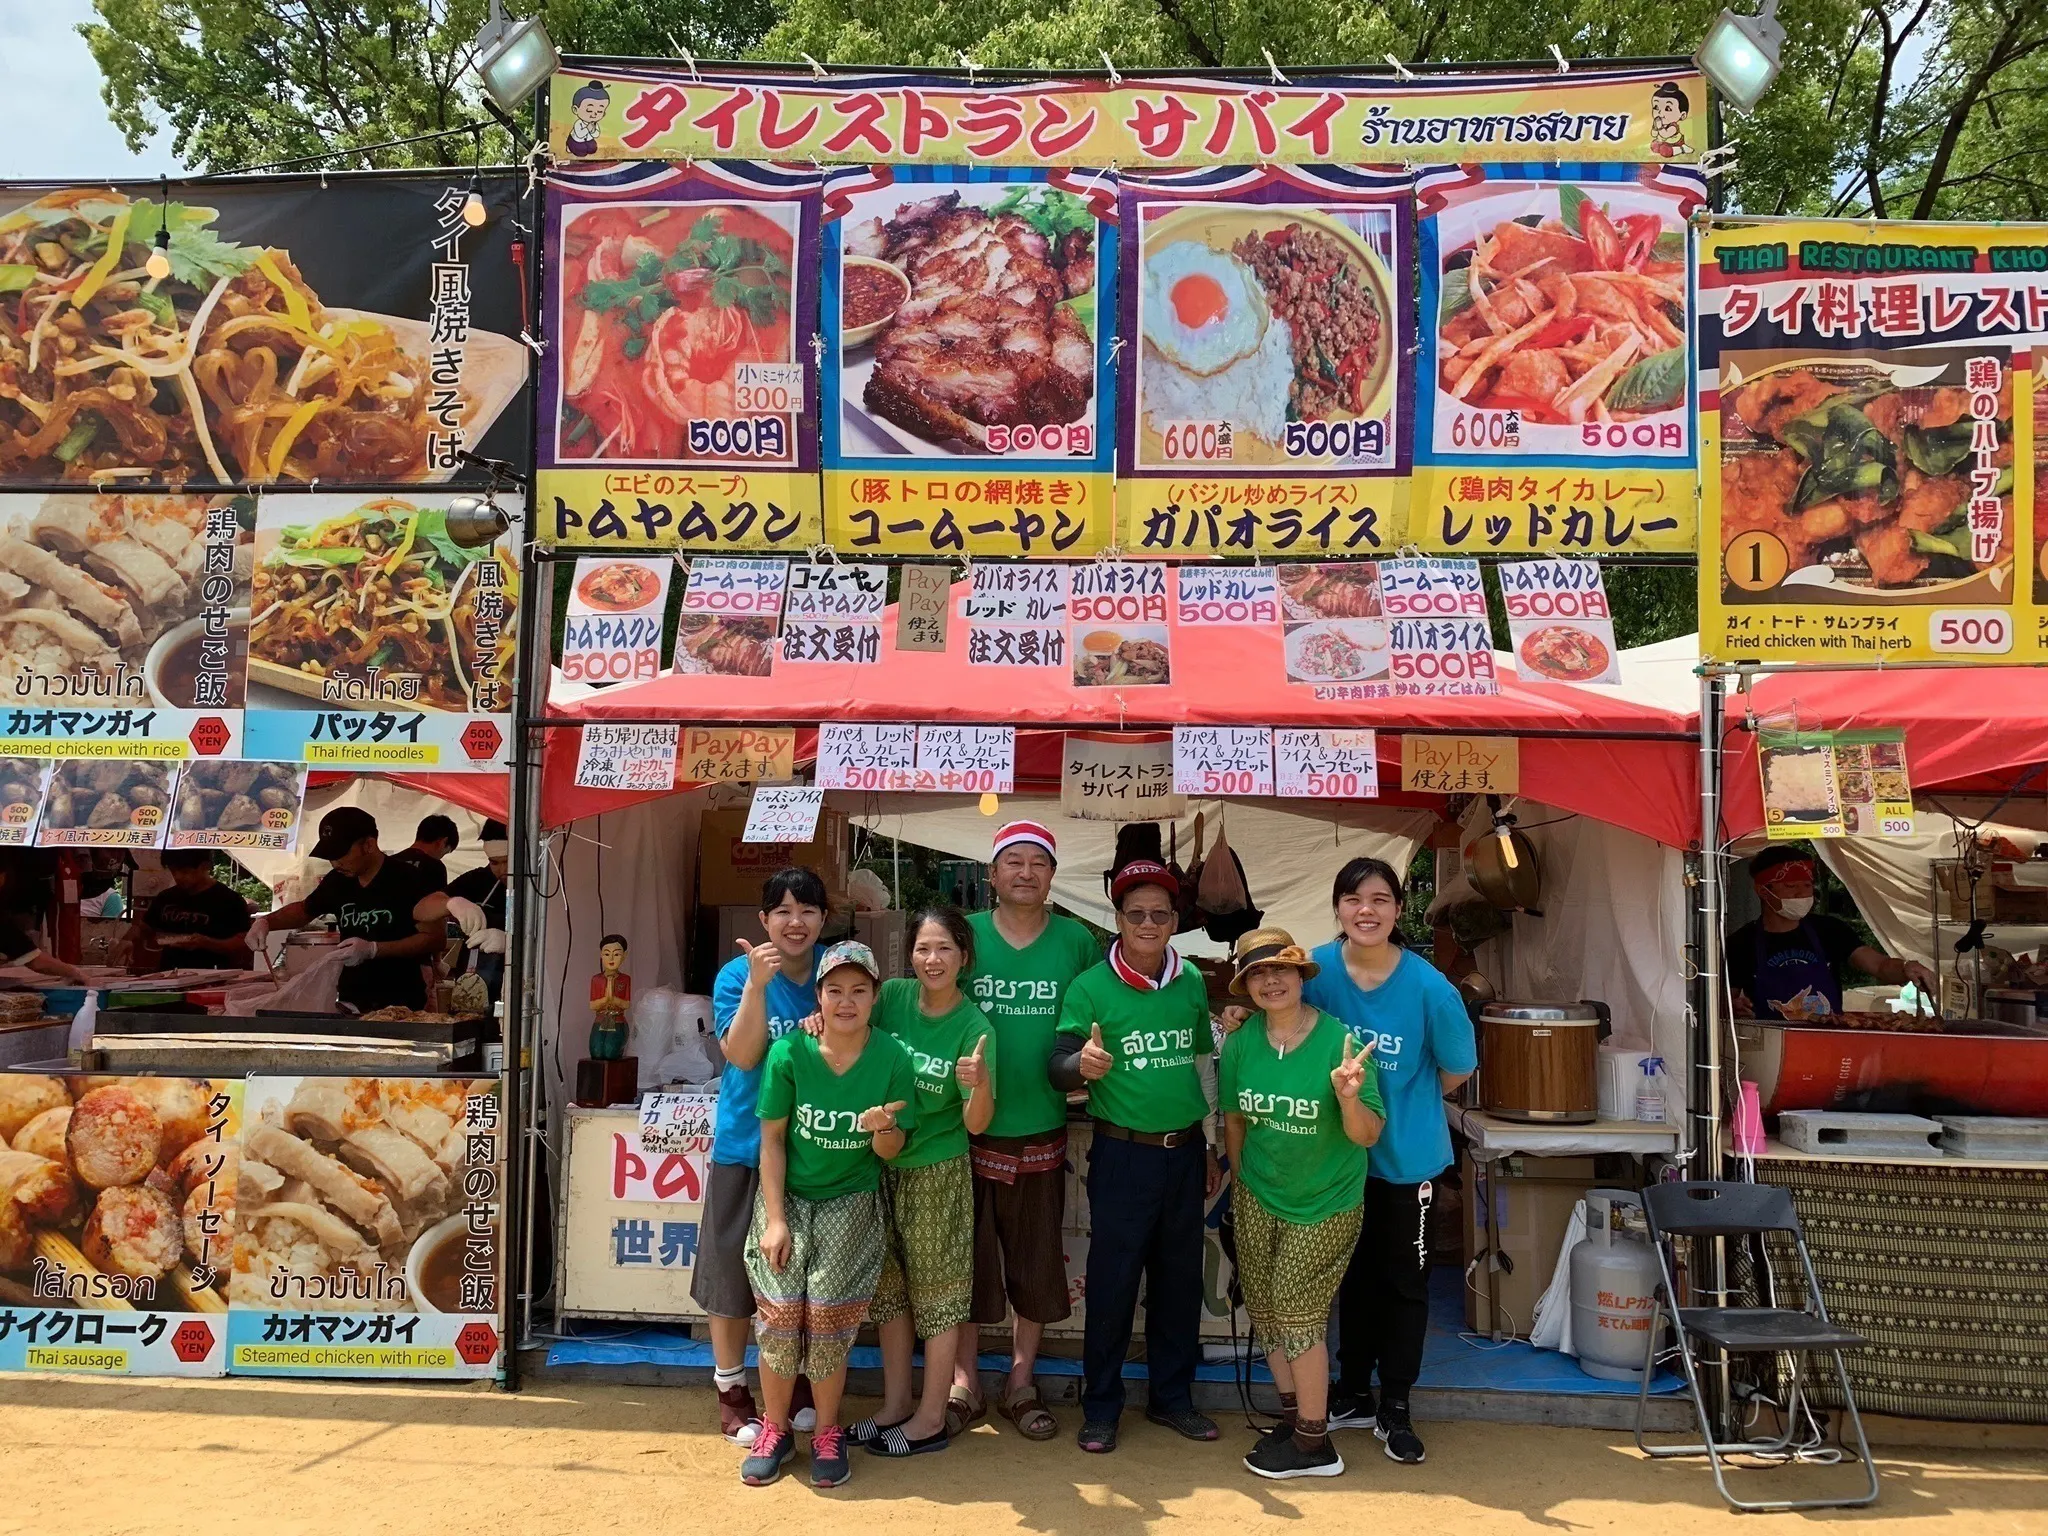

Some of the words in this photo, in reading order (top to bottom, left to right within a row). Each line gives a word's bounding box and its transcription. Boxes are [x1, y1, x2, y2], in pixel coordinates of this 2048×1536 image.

[621, 83, 1098, 159] タイレストラン
[1127, 90, 1346, 159] サバイ
[1361, 105, 1629, 147] ร้านอาหารสบาย
[1716, 244, 1787, 272] THAI
[1801, 243, 1976, 271] RESTAURANT
[1722, 282, 2048, 336] タイ料理レスト
[427, 186, 473, 472] タイ風焼きそば
[736, 387, 802, 411] 300円
[688, 418, 787, 455] 500円
[986, 424, 1093, 454] 500円
[1164, 422, 1219, 459] 600
[1284, 420, 1385, 457] 500円
[1450, 412, 1504, 448] 600
[1581, 423, 1682, 450] 500円
[1968, 359, 2003, 562] 鶏のハーブ揚げ
[604, 474, 750, 498] (エビのスープ)
[849, 478, 1088, 507] (豚トロの網焼き)
[1165, 481, 1359, 507] (バジル炒めライス)
[1446, 476, 1666, 504] (鶏肉タイカレー)
[553, 495, 802, 543] トムヤムクン
[848, 507, 1088, 549] コームーヤン
[1143, 505, 1385, 549] ガパオライス
[1441, 506, 1678, 549] レッドカレー
[688, 571, 785, 591] コームーヤン
[907, 568, 945, 594] Pay
[971, 566, 1059, 593] ガパオライス
[1071, 565, 1165, 596] ガパオライス
[1382, 572, 1480, 592] コームーヤン
[1502, 564, 1600, 592] トムヤムクン
[683, 590, 781, 613] 500円
[788, 591, 883, 613] トムヤムクン
[1178, 579, 1276, 602] レッドカレー
[194, 507, 238, 706] 鶏肉のせご飯
[908, 591, 946, 617] Pay
[964, 598, 1016, 618] レッド
[1026, 598, 1067, 622] カレー
[1071, 594, 1167, 622] 500円
[1178, 601, 1277, 623] 500円
[1385, 593, 1486, 616] 500円
[1505, 591, 1608, 619] 500円
[565, 616, 662, 650] トムヤムクン
[783, 623, 881, 664] 注文受付
[1390, 621, 1492, 651] ガパオライス
[1725, 634, 1760, 649] Fried
[1764, 635, 1816, 649] chicken
[1820, 635, 1847, 649] with
[1852, 636, 1876, 650] Thai
[1880, 637, 1912, 650] herb
[1940, 619, 2003, 645] 500
[968, 629, 1065, 666] 注文受付
[562, 648, 659, 681] 500円
[1390, 649, 1495, 681] 500円
[14, 662, 146, 697] ข้าวมันไก่
[321, 667, 421, 701] ผัดไทย
[6, 709, 157, 737] カオマンガイ
[198, 724, 221, 735] 500
[310, 712, 427, 743] パッタイ
[470, 728, 493, 739] 500
[198, 736, 222, 747] YEN
[470, 740, 494, 751] YEN
[690, 729, 790, 762] PayPay
[824, 726, 864, 744] ガパオ
[876, 726, 915, 744] レッド
[924, 729, 962, 745] ガパオ
[975, 728, 1014, 745] レッド
[1178, 731, 1219, 746] ガパオ
[1230, 729, 1270, 746] レッド
[1280, 732, 1321, 748] ガパオ
[1331, 733, 1366, 747] レッド
[56, 743, 113, 756] chicken
[118, 743, 149, 756] with
[153, 744, 181, 757] rice
[311, 745, 339, 758] Thai
[341, 745, 370, 759] fried
[373, 746, 424, 760] noodles
[824, 742, 853, 756] ライス
[858, 742, 868, 755] &
[873, 744, 911, 756] カレー
[922, 744, 952, 758] ライス
[958, 744, 968, 757] &
[973, 746, 1010, 758] カレー
[1178, 745, 1210, 759] ライス
[1214, 745, 1225, 758] &
[1231, 746, 1268, 759] カレー
[1280, 747, 1312, 761] ライス
[1316, 747, 1328, 760] &
[1334, 749, 1372, 761] カレー
[1413, 740, 1498, 771] PayPay
[583, 758, 616, 774] 冷凍
[622, 759, 674, 773] レッドカレー
[839, 754, 911, 768] ハーフセット
[939, 757, 1010, 770] ハーフセット
[1196, 759, 1270, 773] ハーフセット
[1299, 761, 1373, 775] ハーフセット
[625, 771, 669, 783] ガパオ
[887, 768, 963, 790] 仕込中
[1080, 780, 1129, 800] サバイ
[1135, 780, 1169, 799] 山形
[8, 815, 28, 824] YEN
[9, 806, 29, 816] 500
[137, 817, 157, 827] YEN
[138, 808, 158, 818] 500
[268, 810, 289, 820] 500
[759, 811, 814, 824] 200円
[1771, 809, 1782, 821] 5
[1884, 806, 1906, 815] ALL
[267, 819, 288, 829] YEN
[1823, 825, 1841, 834] 500
[1883, 821, 1911, 832] 500
[44, 831, 154, 845] タイ風ホンシリ焼き
[175, 832, 285, 847] タイ風ホンシリ焼き
[973, 974, 1058, 1000] สบาย
[995, 1003, 1056, 1016] Thailand
[1120, 1027, 1194, 1056] สบาย
[1123, 1060, 1131, 1072] I
[1150, 1053, 1195, 1070] Thailand
[1237, 1087, 1320, 1120] สบาย
[1260, 1116, 1318, 1135] Thailand
[613, 1131, 709, 1202] トム
[459, 1093, 499, 1311] 鶏肉のせご飯
[611, 1219, 701, 1267] 世界
[269, 1262, 407, 1301] ข้าวมันไก่
[0, 1309, 169, 1347] サイクローク
[181, 1329, 205, 1341] 500
[261, 1313, 421, 1344] カオマンガイ
[464, 1330, 489, 1342] 500
[27, 1349, 60, 1366] Thai
[63, 1352, 123, 1369] sausage
[180, 1343, 206, 1354] YEN
[242, 1348, 310, 1363] Steamed
[315, 1348, 375, 1365] chicken
[380, 1350, 414, 1365] with
[417, 1351, 447, 1366] rice
[463, 1343, 490, 1355] YEN
